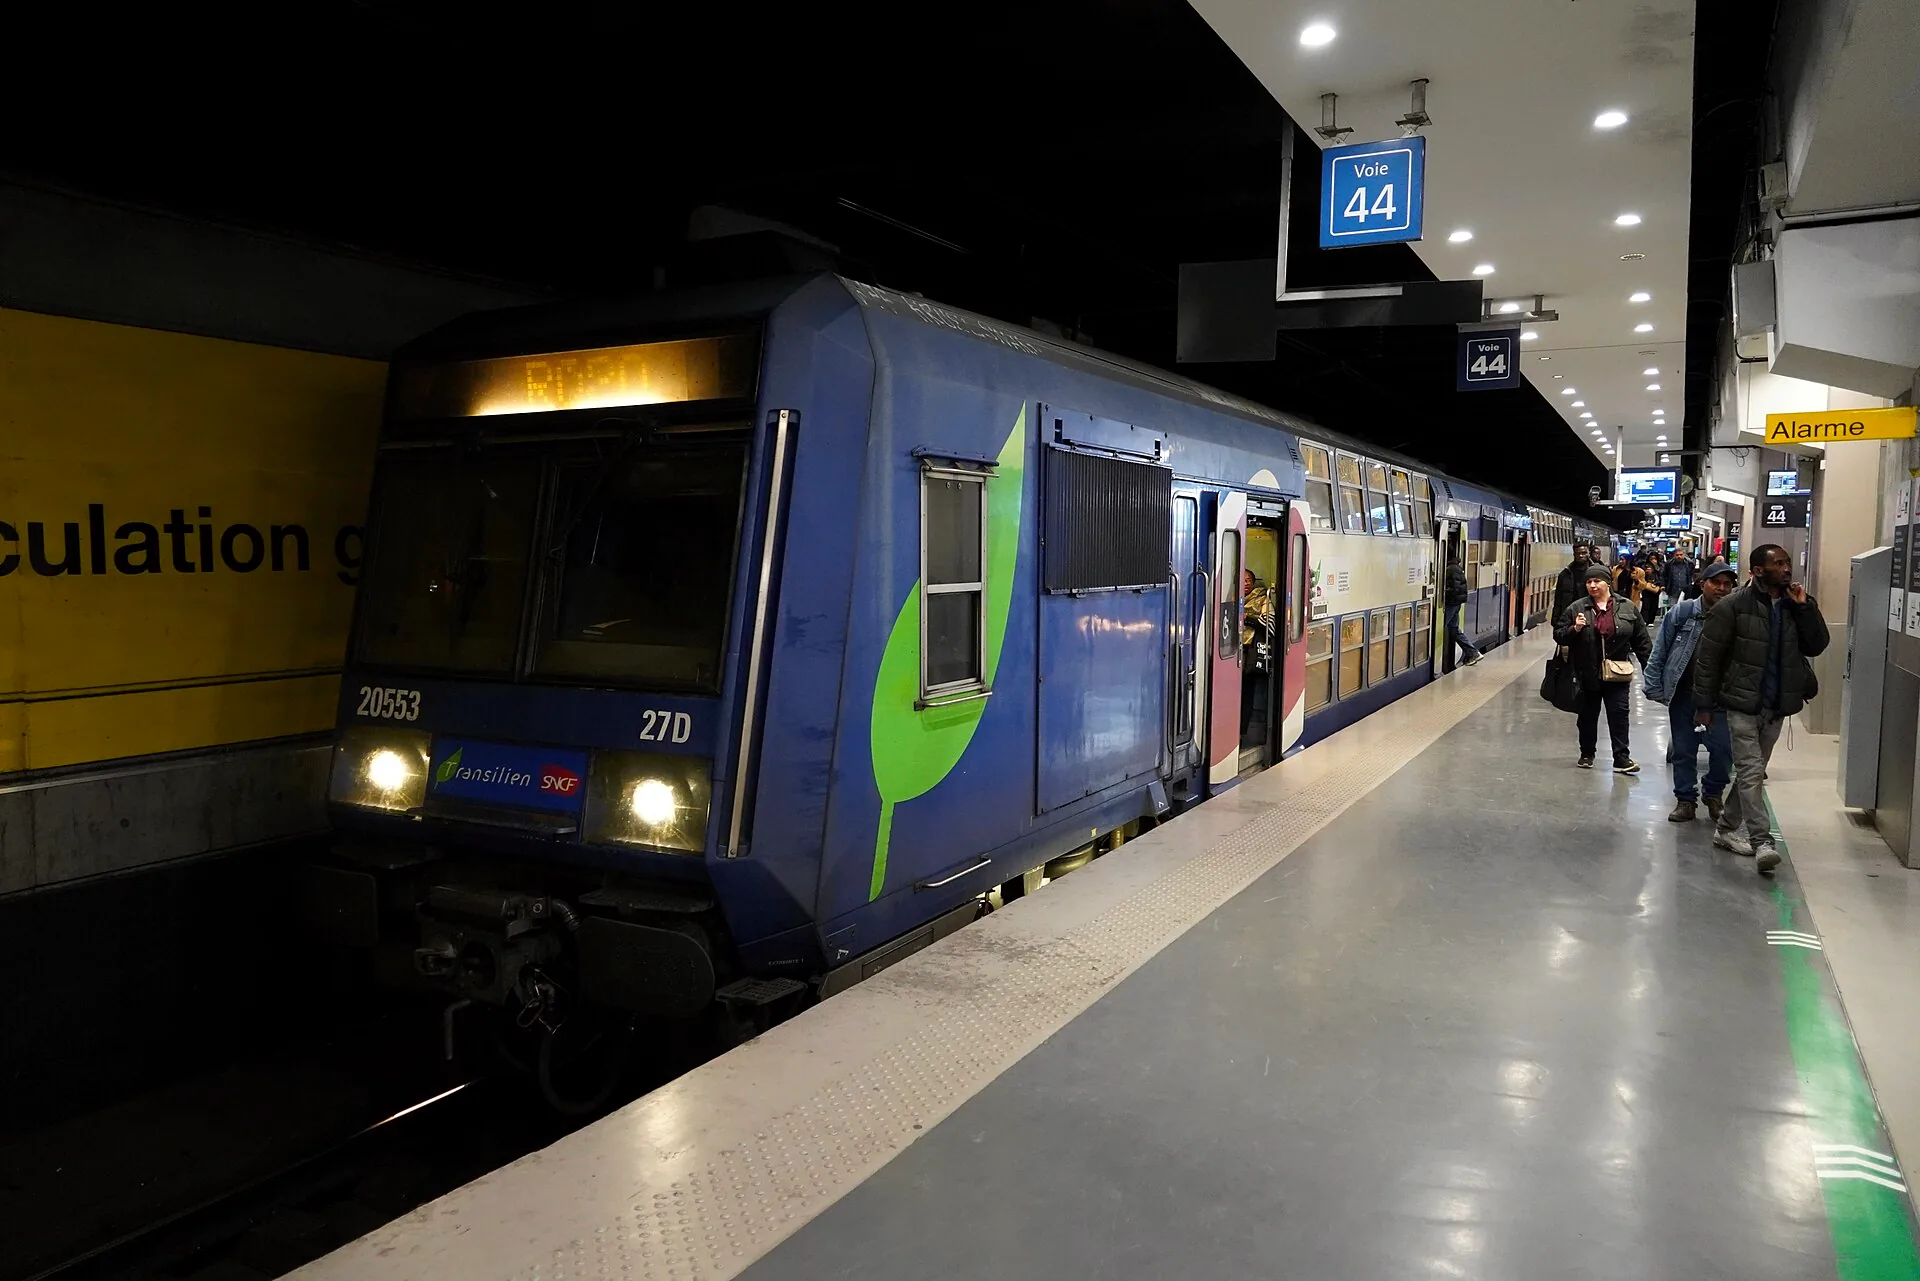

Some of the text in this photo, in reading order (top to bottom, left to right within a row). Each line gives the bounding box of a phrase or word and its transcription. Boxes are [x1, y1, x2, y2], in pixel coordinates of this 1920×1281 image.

[1354, 162, 1389, 178] Voie
[1343, 183, 1397, 223] 44
[1478, 343, 1500, 352] Voie
[1470, 354, 1507, 376] 44
[1771, 421, 1864, 439] Alarme
[1767, 510, 1787, 522] 44
[356, 685, 421, 722] 20553
[639, 709, 692, 744] 27D
[444, 761, 531, 788] Transilien
[541, 774, 579, 792] SNCF
